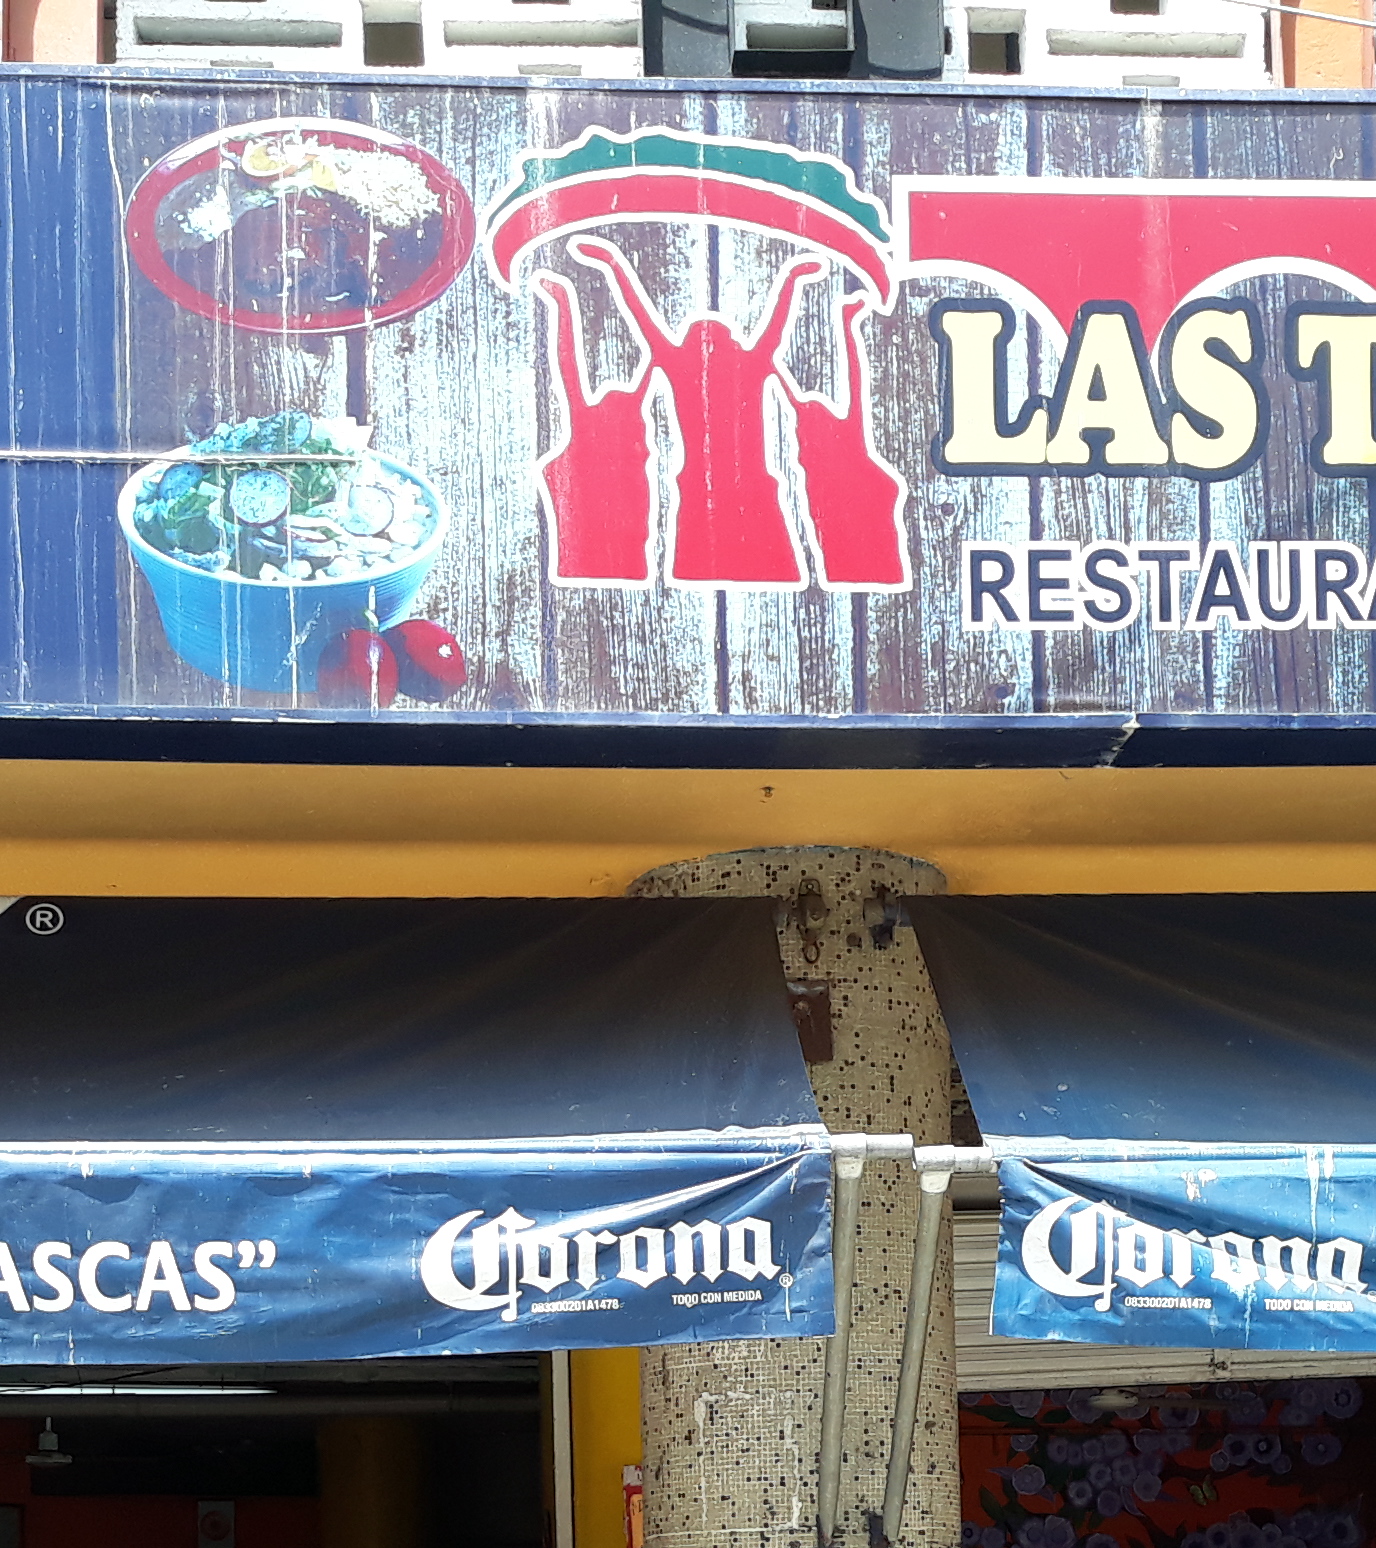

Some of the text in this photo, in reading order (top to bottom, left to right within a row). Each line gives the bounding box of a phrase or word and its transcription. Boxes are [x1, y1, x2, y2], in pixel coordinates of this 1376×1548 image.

[931, 295, 1269, 481] LAS
[421, 1206, 781, 1321] Corona
[672, 1289, 763, 1307] TODO CON MEDIDA
[1022, 1196, 1370, 1312] Corona
[1264, 1299, 1292, 1311] TODO
